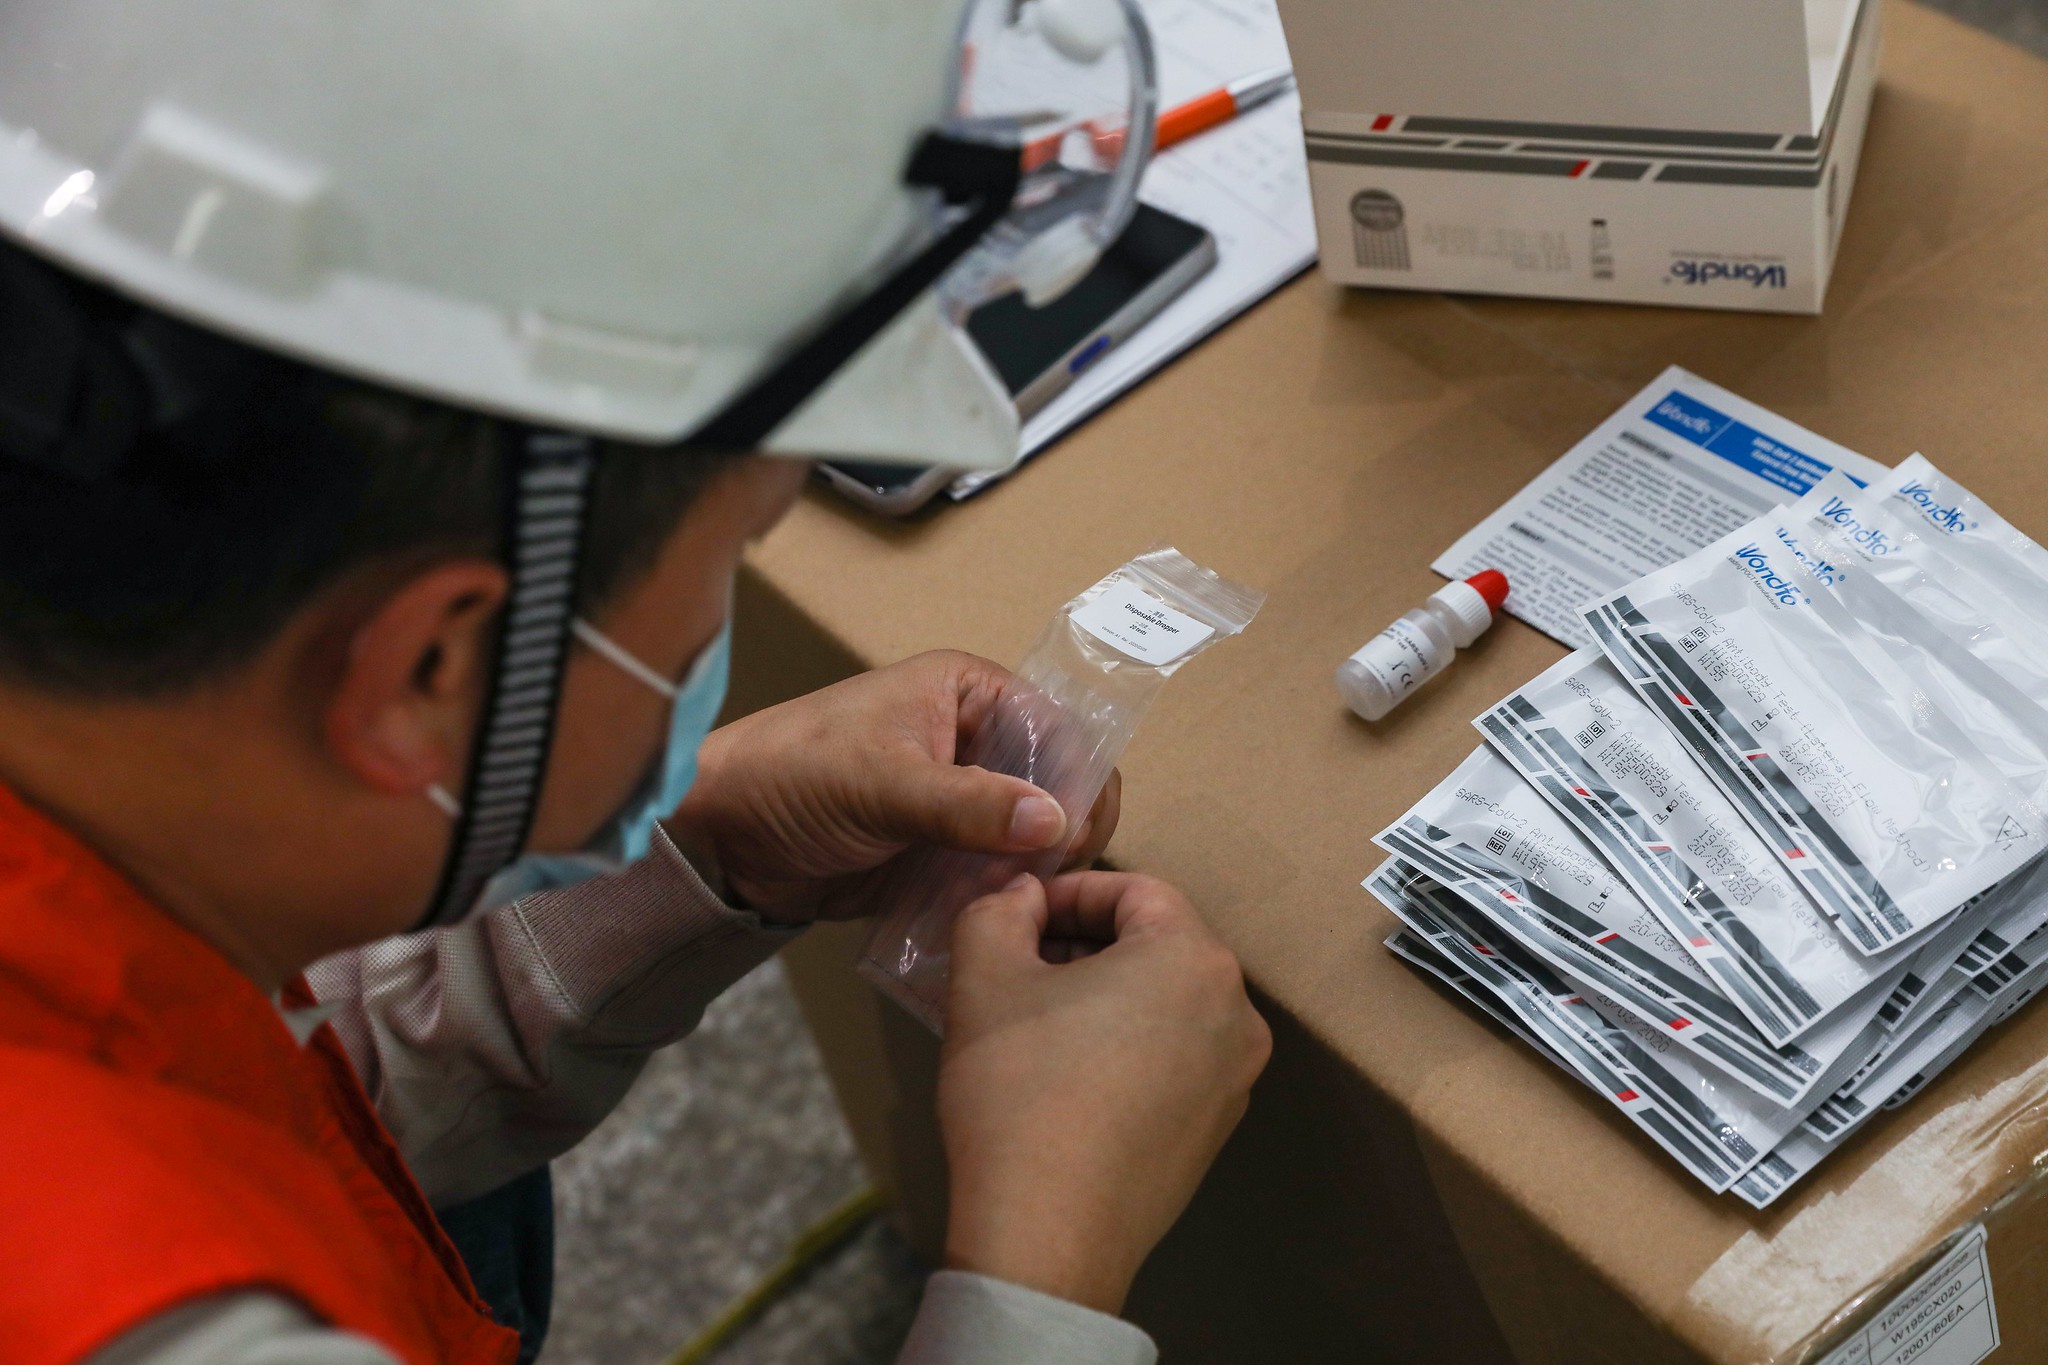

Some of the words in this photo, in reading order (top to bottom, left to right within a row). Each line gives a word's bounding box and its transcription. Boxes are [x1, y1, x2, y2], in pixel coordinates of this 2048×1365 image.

[1668, 260, 1785, 288] Wondfo
[1818, 495, 1889, 559] Wondfo
[1898, 478, 1966, 537] Wondfo
[1734, 541, 1801, 609] Wondfo
[1740, 566, 1756, 582] POCT
[1752, 579, 1781, 611] Manufacturer
[1124, 603, 1156, 624] Disposable
[1155, 620, 1180, 634] Dropper
[1667, 580, 1725, 637] SARS-CoV-2
[1720, 635, 1773, 690] Antibody
[1772, 690, 1801, 720] Test
[1697, 652, 1726, 683] W195
[1708, 643, 1766, 704] W19500329
[1563, 675, 1622, 730] SARS-CoV-2
[1619, 729, 1674, 782] Antibody
[1673, 780, 1705, 811] Test
[1596, 748, 1629, 781] W195
[1608, 738, 1669, 799] W19500329
[1790, 735, 1858, 808] 19/03/2021
[1777, 743, 1847, 819] 20/03/2020
[1454, 785, 1528, 831] SARS-CoV-2
[1528, 824, 1597, 873] Antibody
[1510, 847, 1547, 876] W195
[1518, 835, 1595, 888] W19500329
[1686, 837, 1753, 908] 20/03/2020
[1697, 827, 1763, 897] 19/03/2021
[1541, 918, 1554, 929] IN
[1551, 923, 1579, 945] VITRO
[1578, 939, 1628, 974] DIAGNOSTIC
[1627, 969, 1647, 985] USE
[1646, 981, 1670, 1000] ONLY
[1627, 917, 1714, 979] 20/03/20
[1891, 1280, 1962, 1345] W195CX020
[1896, 1304, 1964, 1365] 1200T/60EA
